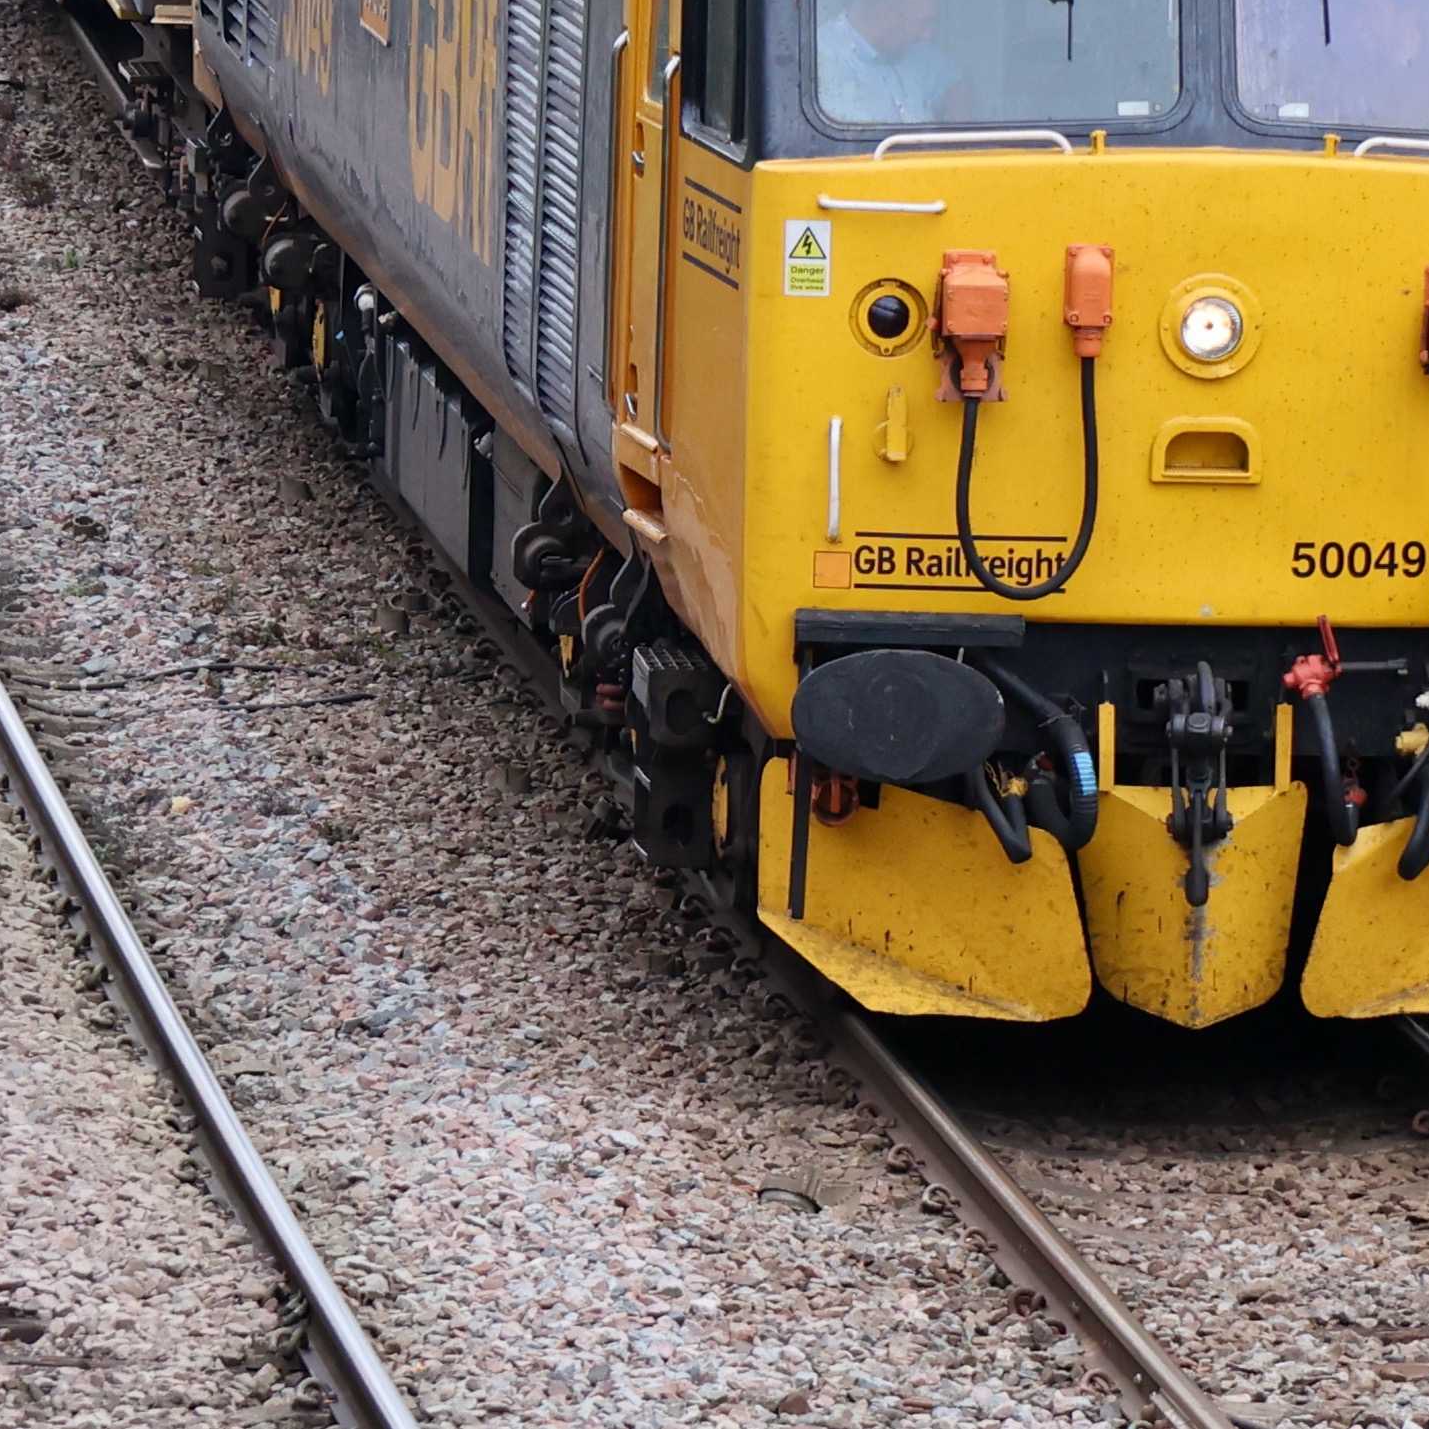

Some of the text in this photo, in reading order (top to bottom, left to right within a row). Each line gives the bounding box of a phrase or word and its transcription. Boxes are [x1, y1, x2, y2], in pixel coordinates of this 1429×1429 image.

[697, 203, 741, 275] Railfreight
[790, 266, 825, 276] Danger
[854, 544, 1067, 586] GB Raileight
[1291, 541, 1426, 578] 50049
